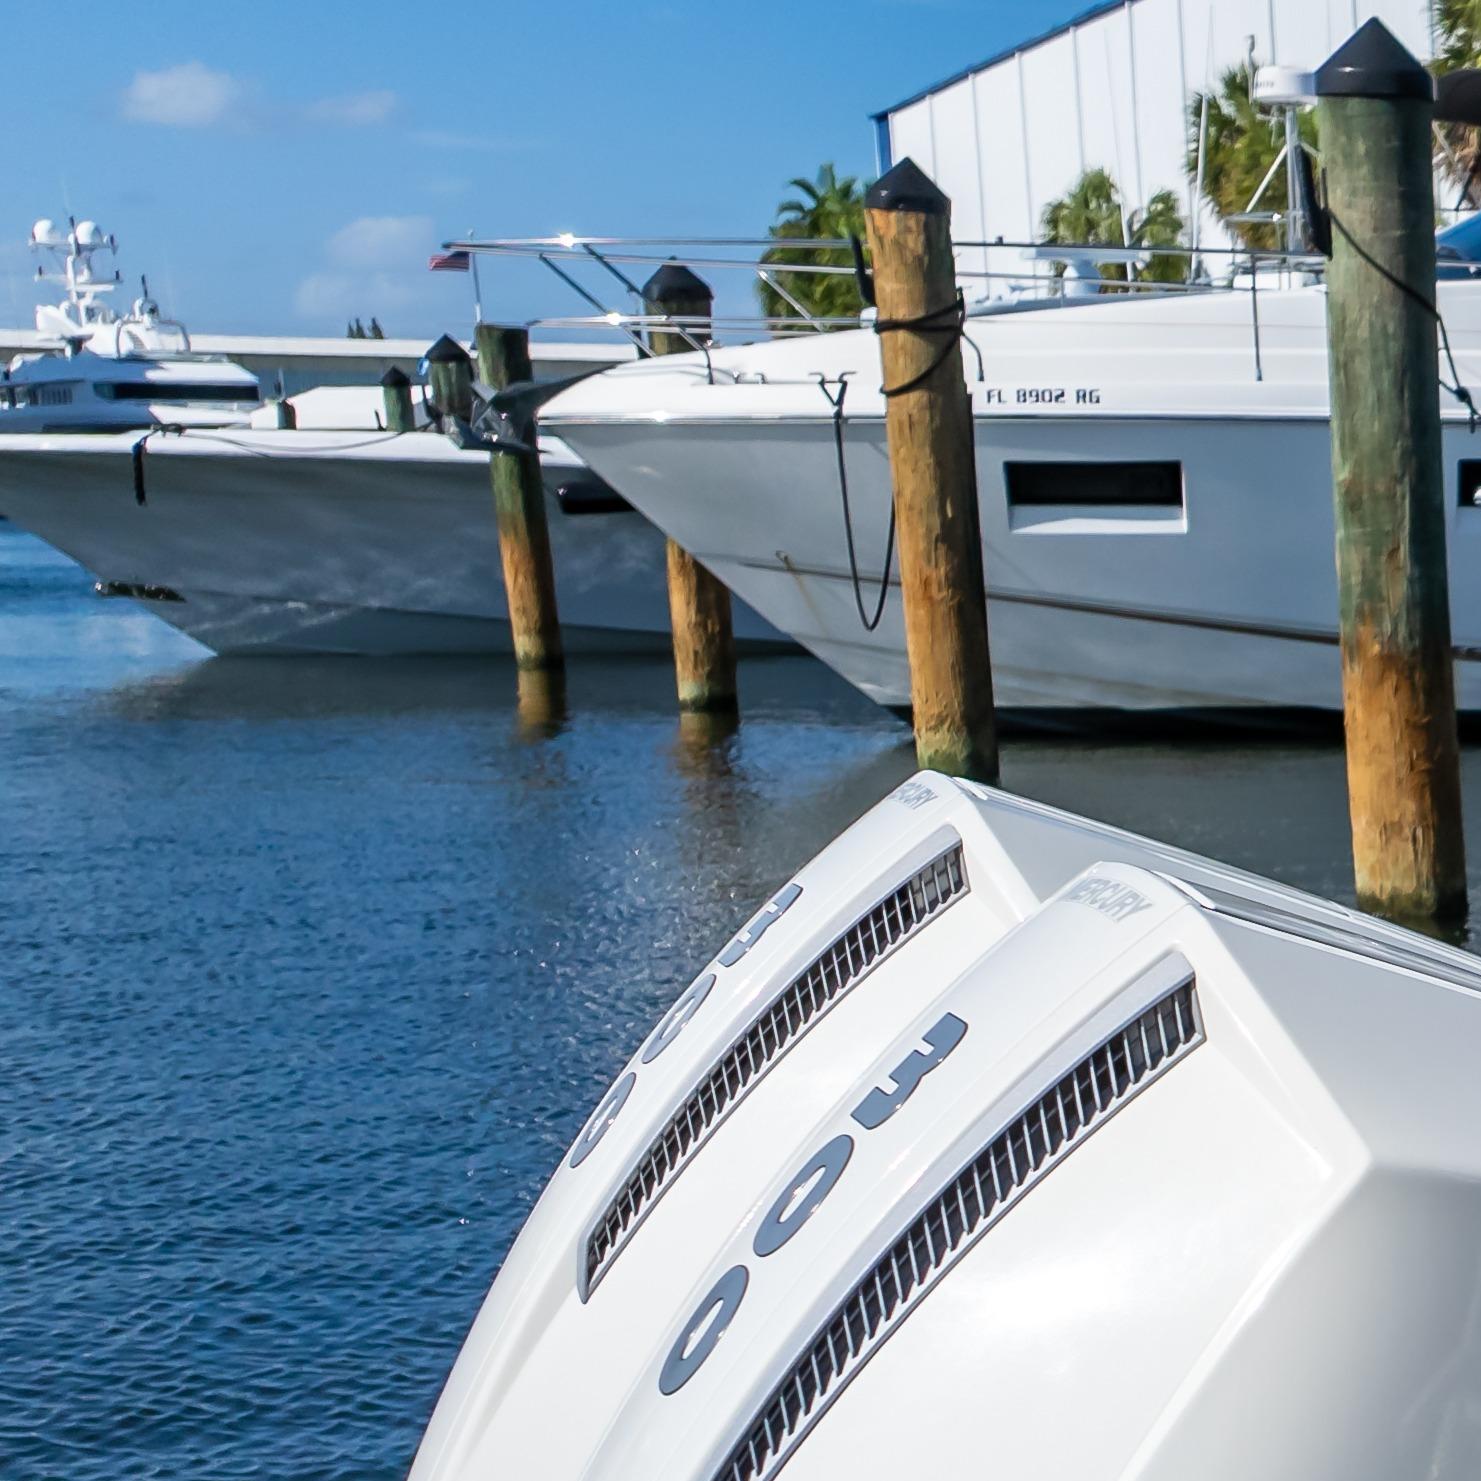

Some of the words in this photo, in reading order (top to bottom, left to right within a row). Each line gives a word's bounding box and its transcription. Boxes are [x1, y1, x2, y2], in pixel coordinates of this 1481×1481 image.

[986, 387, 1007, 404] FL
[1015, 387, 1066, 404] 8902
[1075, 387, 1101, 404] RG
[658, 1011, 968, 1396] 300
